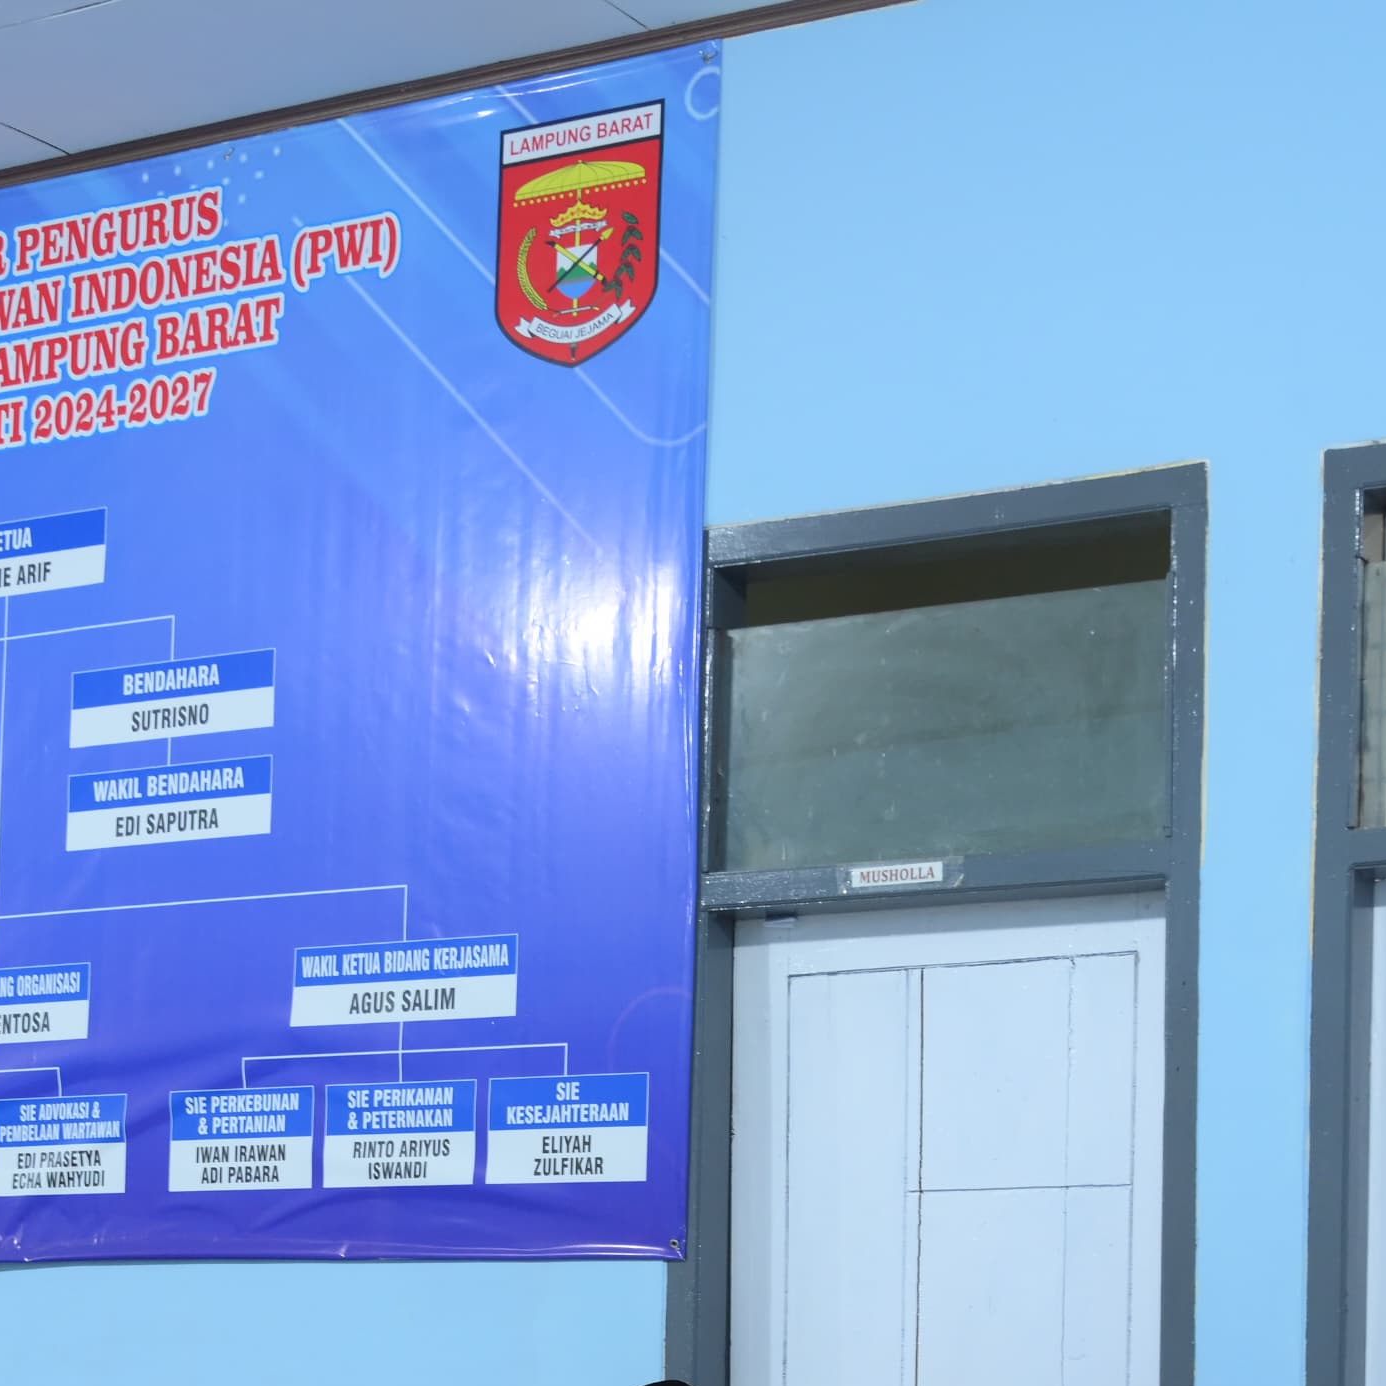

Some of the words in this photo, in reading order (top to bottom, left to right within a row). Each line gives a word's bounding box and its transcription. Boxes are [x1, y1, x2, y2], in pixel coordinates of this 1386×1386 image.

[510, 126, 591, 156] LAMPUNG
[597, 113, 653, 139] BARAT
[16, 191, 220, 270] PENGURUS
[71, 240, 282, 317] INDONESIA
[294, 216, 397, 287] (PWI)
[156, 297, 281, 360] BARAT
[535, 323, 574, 341] BEGUAI
[574, 312, 615, 340] JEJAMA
[34, 371, 214, 440] 2024-2027
[16, 561, 52, 586] ARIF
[122, 664, 220, 696] BENDAHARA
[131, 703, 209, 732] SUTRISNO
[93, 777, 142, 802] WAKIL
[146, 766, 245, 797] BENDAHARA
[115, 815, 141, 837] EDI
[146, 807, 219, 835] SAPUTRA
[859, 866, 935, 883] MUSHOLLA
[301, 955, 339, 978] WAKIL
[342, 952, 381, 976] KETUA
[384, 948, 430, 973] BIDANG
[433, 943, 509, 971] KERJASAMA
[16, 971, 81, 997] ORGANISASI
[349, 990, 395, 1015] AGUS
[401, 987, 455, 1012] SALIM
[347, 1089, 370, 1110] SIE
[372, 1086, 454, 1109] PERIKANAN
[556, 1081, 580, 1102] SIE
[19, 1104, 37, 1121] SIE
[38, 1102, 90, 1120] ADVOKASI
[92, 1101, 101, 1118] &
[185, 1096, 207, 1115] SIE
[210, 1092, 300, 1114] PERKEBUNAN
[506, 1102, 629, 1125] KESEJAHTERAAN
[197, 1117, 209, 1136] &
[211, 1114, 287, 1134] PERTANIAN
[347, 1111, 359, 1130] &
[361, 1107, 453, 1129] PETERNAKAN
[0, 1123, 60, 1142] PEMBELAAN
[62, 1121, 121, 1140] WARTAWAN
[196, 1145, 229, 1164] IWAN
[233, 1143, 287, 1163] IRAWAN
[352, 1140, 395, 1159] RINTO
[398, 1138, 451, 1158] ARIYUS
[541, 1135, 593, 1156] ELIYAH
[17, 1152, 36, 1169] EDI
[39, 1150, 102, 1169] PRASETYA
[368, 1161, 428, 1181] ISWANDI
[533, 1156, 605, 1178] ZULFIKAR
[12, 1172, 42, 1190] ECHA
[46, 1170, 105, 1189] WAHYUDI
[201, 1166, 224, 1184] ADI
[227, 1164, 280, 1183] PABARA
